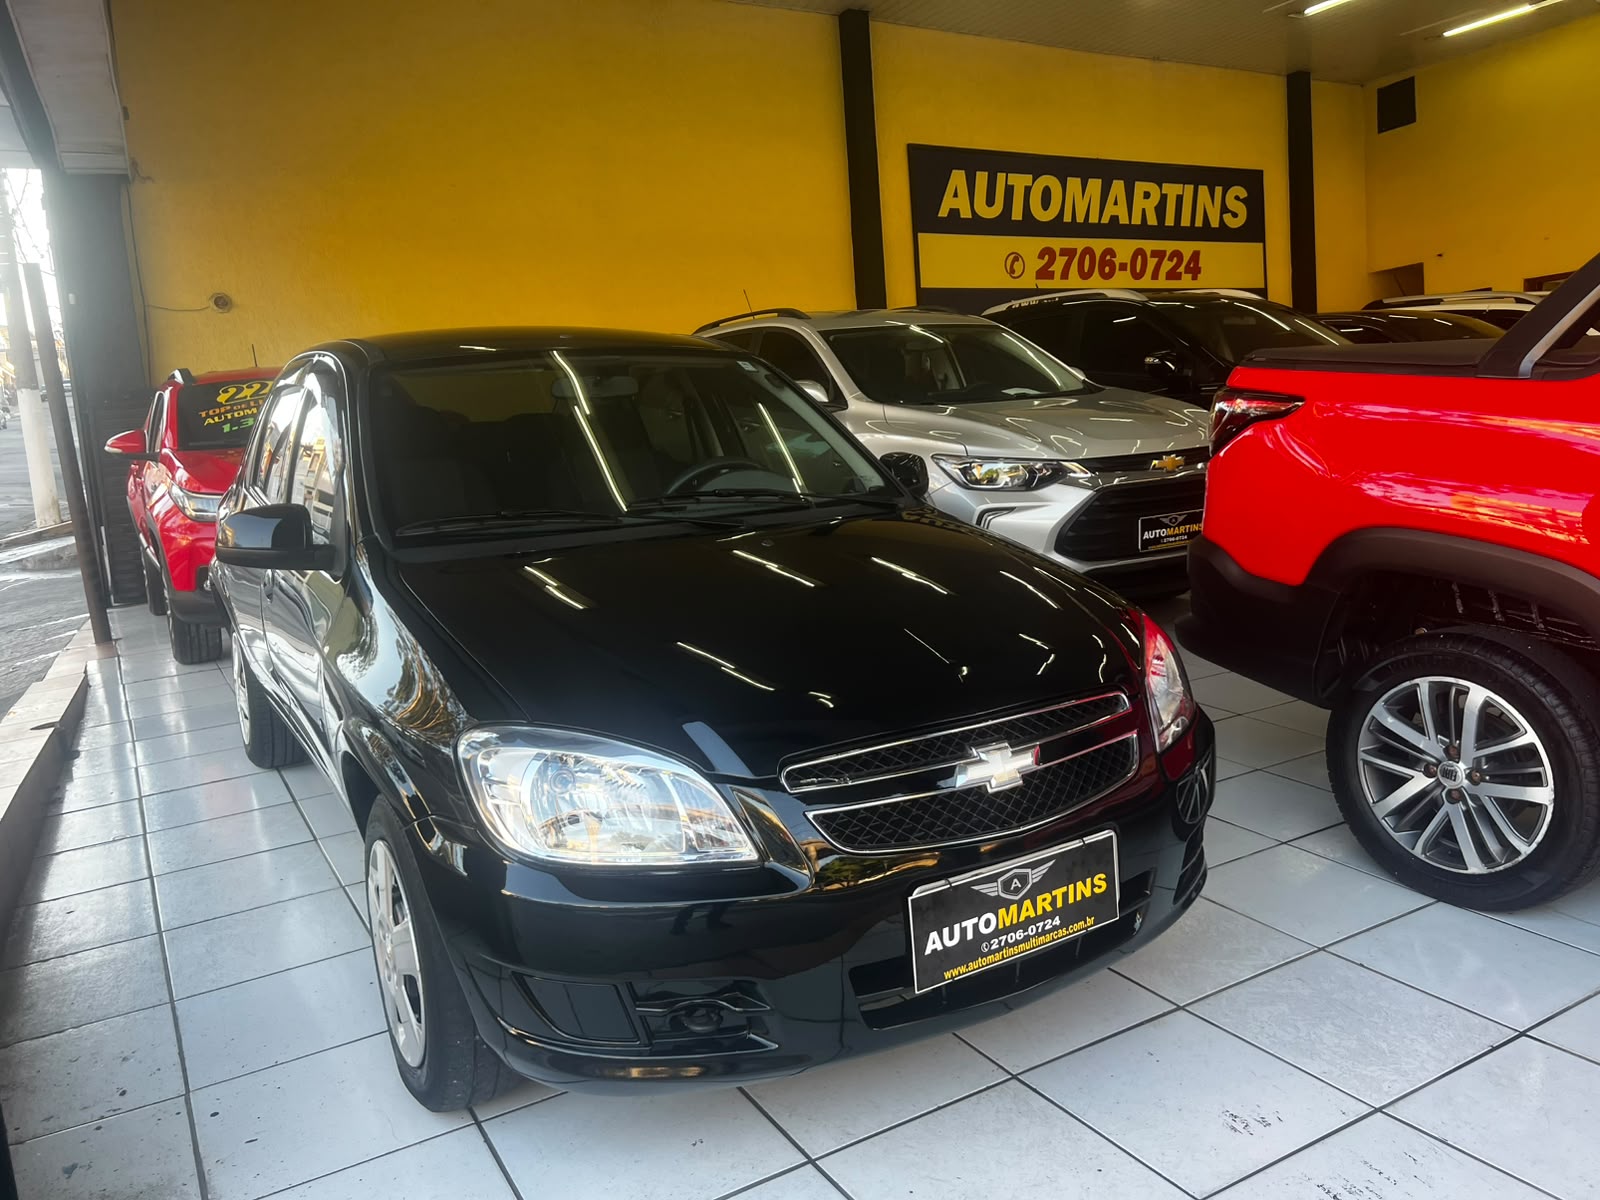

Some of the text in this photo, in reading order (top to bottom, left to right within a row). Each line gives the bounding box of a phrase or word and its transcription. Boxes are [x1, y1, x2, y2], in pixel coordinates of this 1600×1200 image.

[938, 169, 1247, 229] AUTOMARTINS
[1035, 246, 1202, 281] 2706-0724
[217, 381, 273, 404] 22
[199, 406, 231, 417] TOP
[204, 407, 257, 426] AUTOM
[1010, 878, 1021, 890] A
[924, 873, 1108, 956] AUTOMARTINS
[943, 915, 1095, 980] www.automartinsmultimarcas.com.br
[990, 915, 1061, 950] 2706-0724
